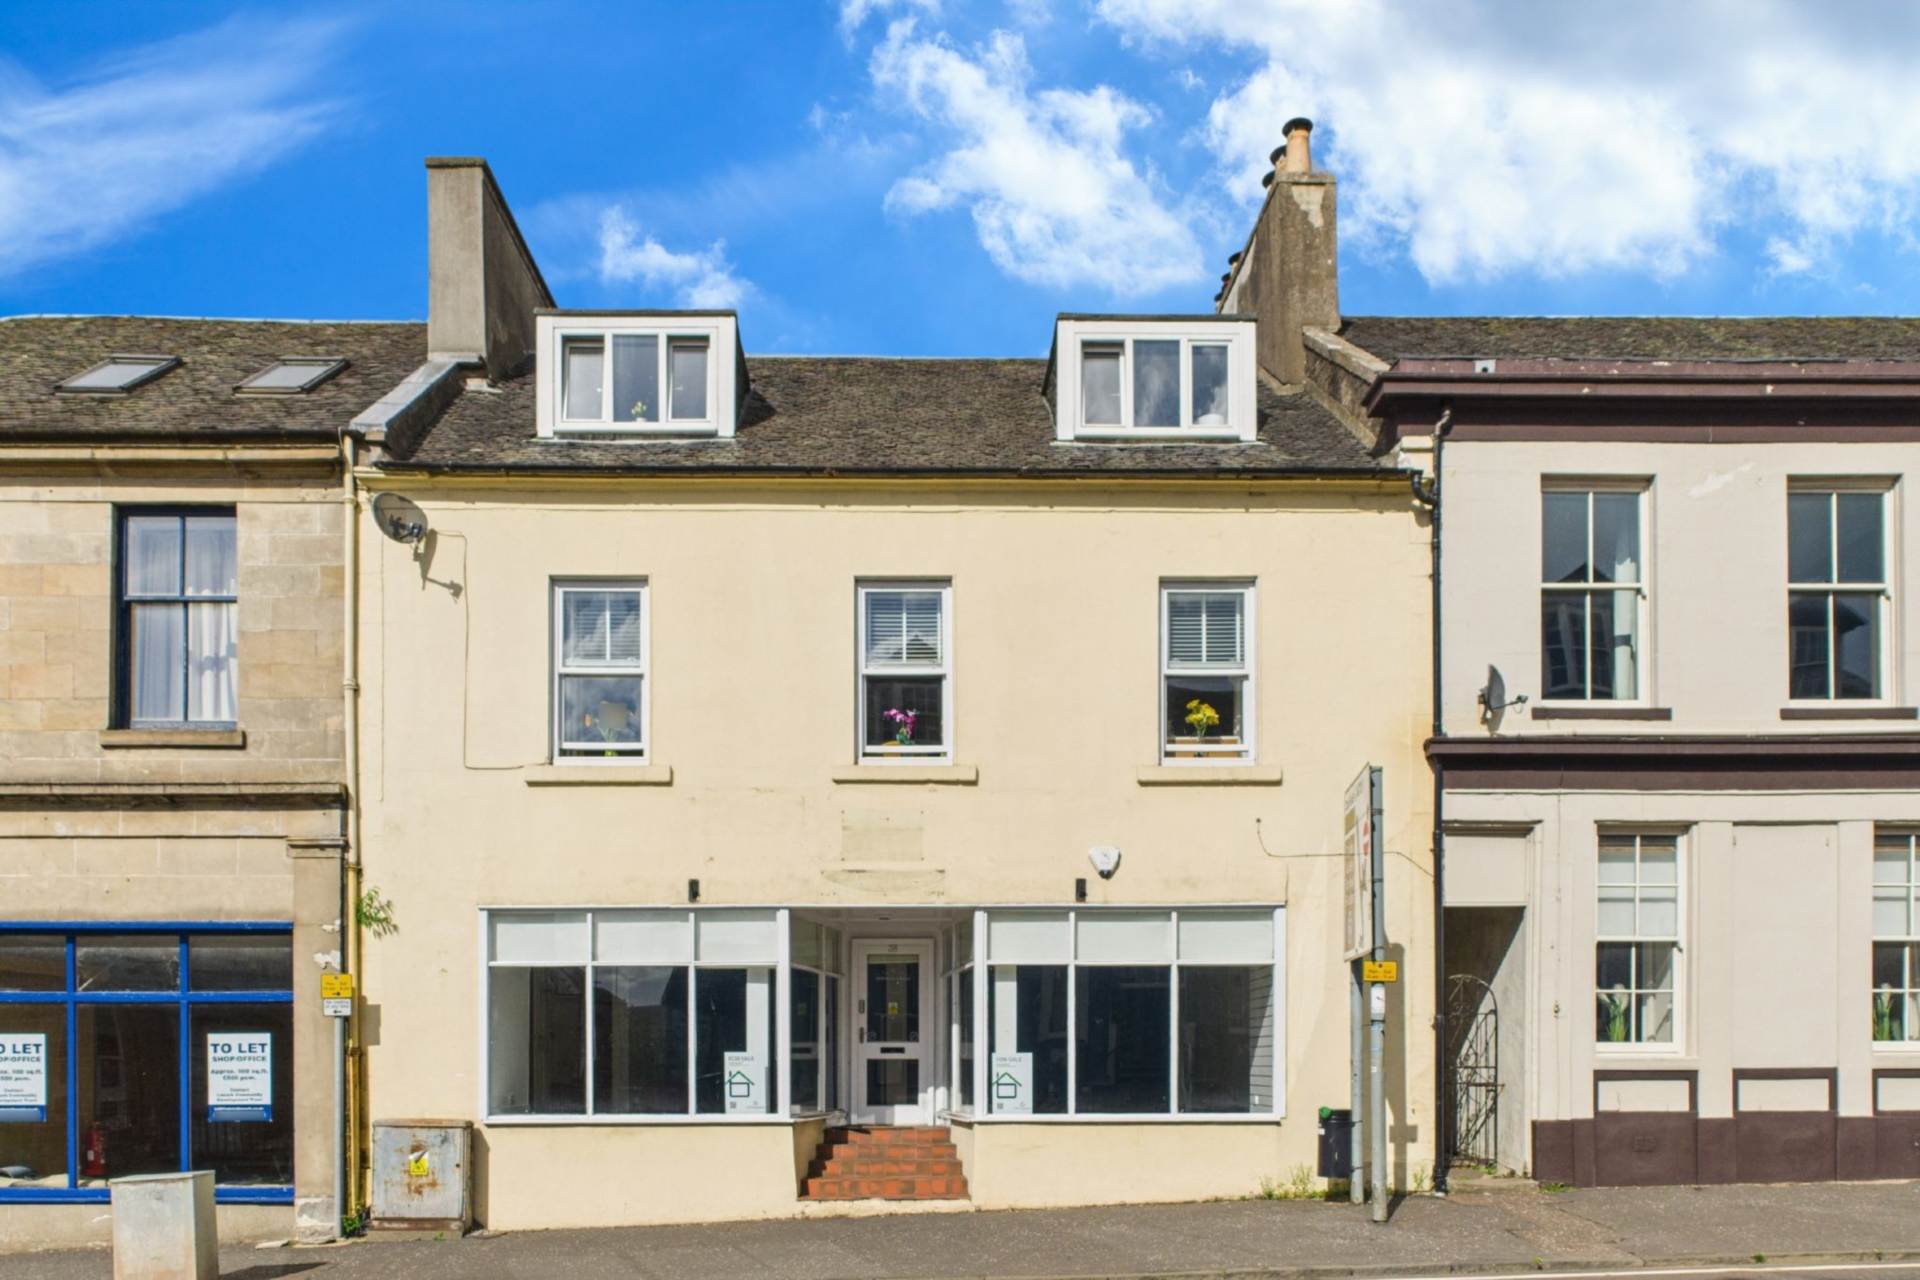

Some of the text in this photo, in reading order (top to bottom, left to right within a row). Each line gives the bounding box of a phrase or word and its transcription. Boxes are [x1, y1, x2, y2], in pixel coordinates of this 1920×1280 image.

[0, 1043, 42, 1054] O LET
[210, 1043, 267, 1053] TO LET
